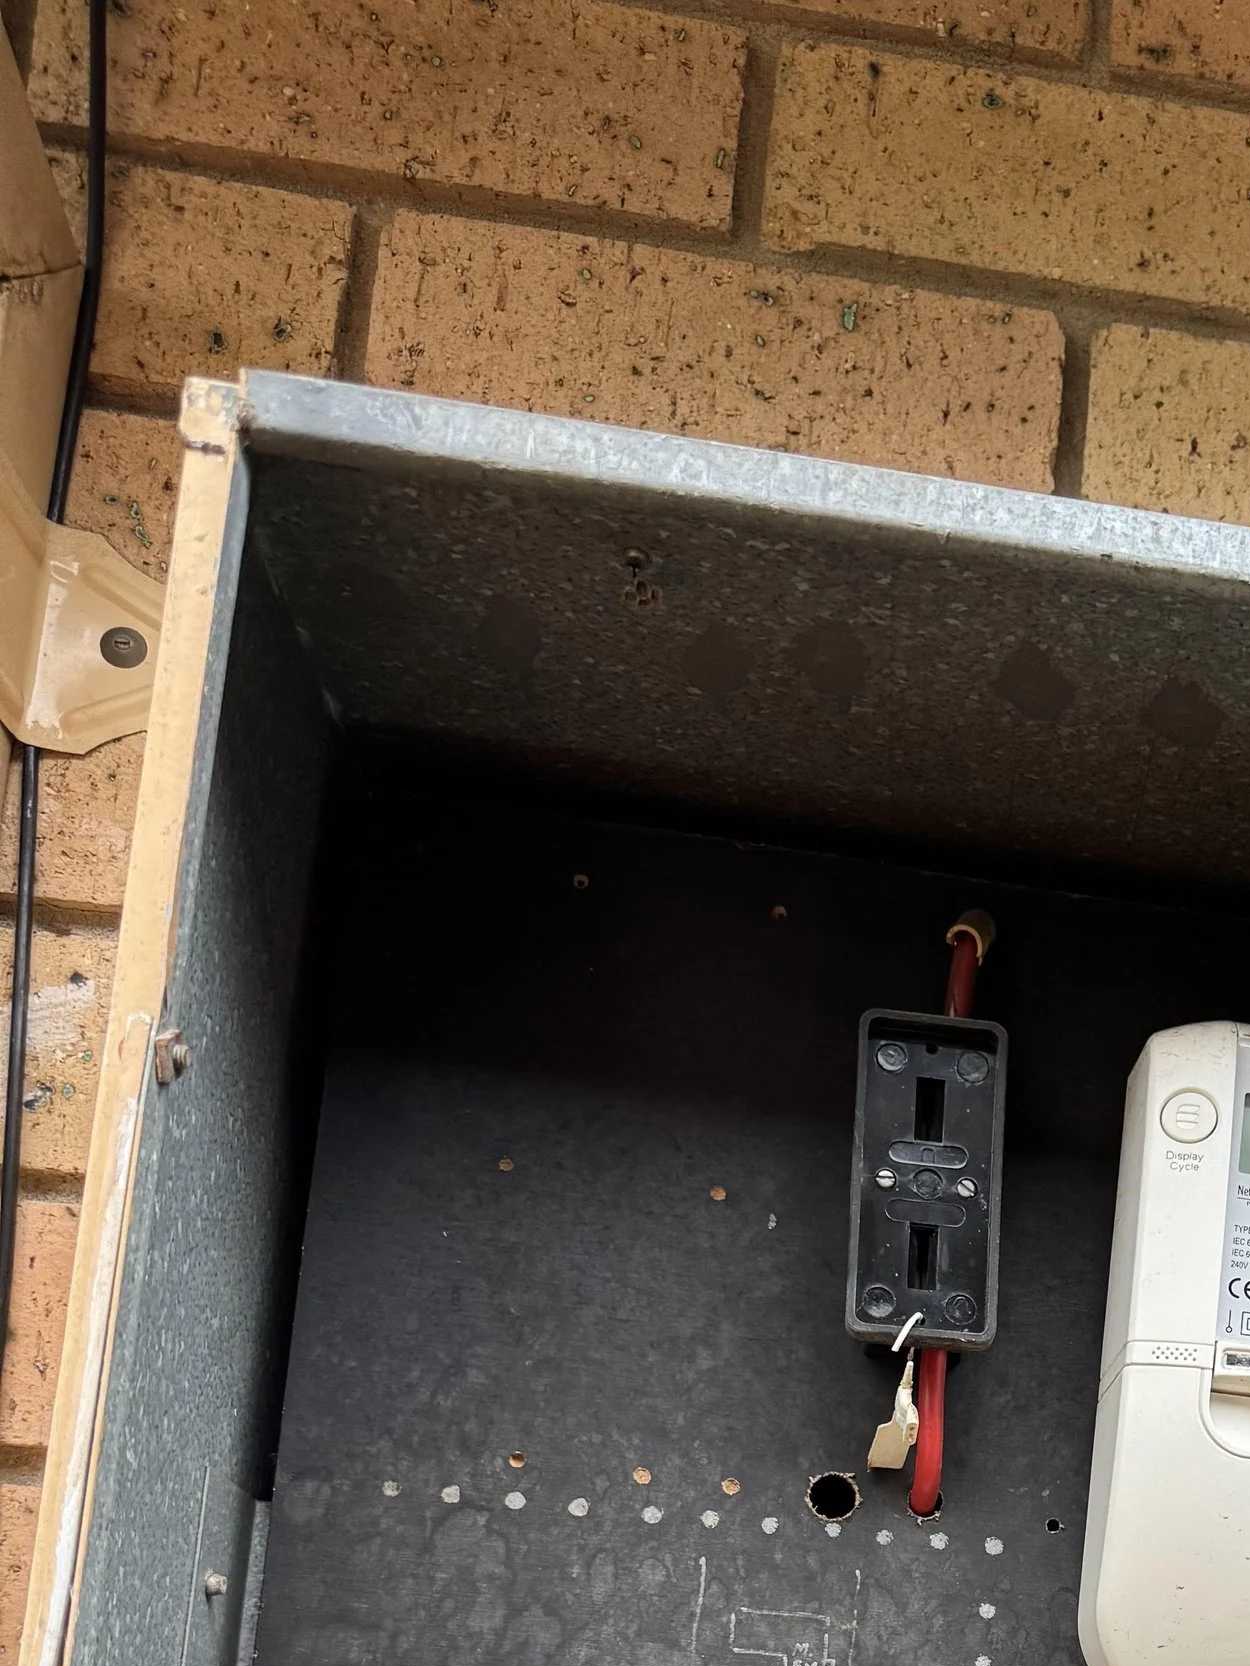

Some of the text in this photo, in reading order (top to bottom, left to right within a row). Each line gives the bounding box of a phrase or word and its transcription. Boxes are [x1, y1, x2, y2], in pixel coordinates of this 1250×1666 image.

[1166, 1151, 1204, 1163] Display
[1170, 1161, 1199, 1172] Cycle
[1232, 1237, 1245, 1246] IEC
[1231, 1249, 1244, 1258] IEC
[1230, 1260, 1248, 1269] 240V
